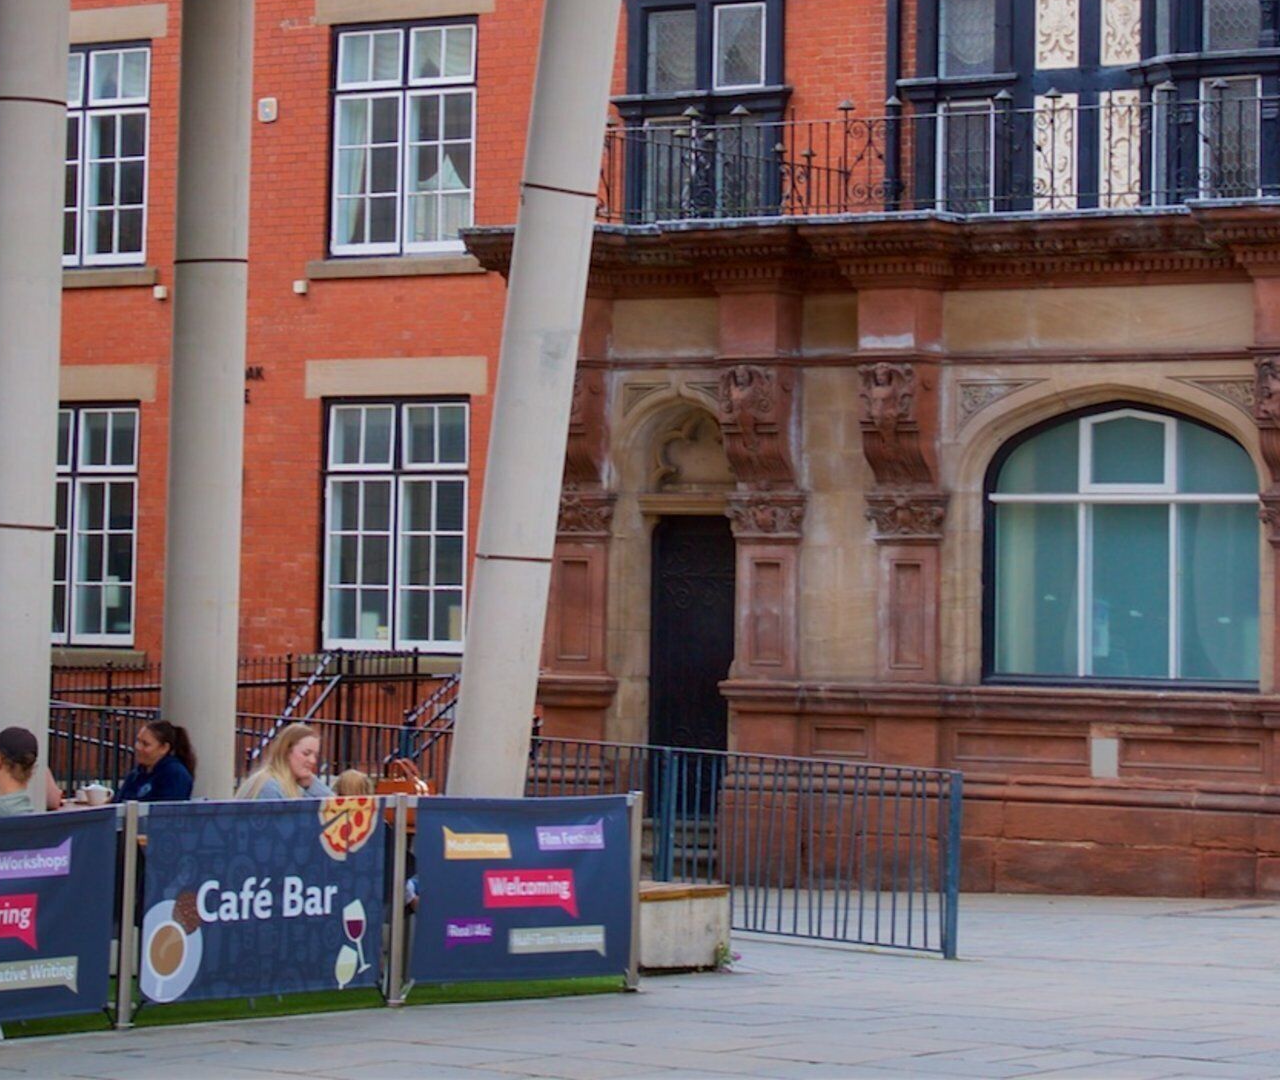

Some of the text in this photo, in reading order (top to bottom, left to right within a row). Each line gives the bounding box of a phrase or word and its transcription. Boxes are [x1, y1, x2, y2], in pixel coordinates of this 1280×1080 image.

[245, 366, 265, 381] AK
[539, 832, 561, 845] Film
[487, 875, 571, 900] Welcoming
[196, 876, 338, 922] Café Bar
[30, 962, 74, 980] Writing
